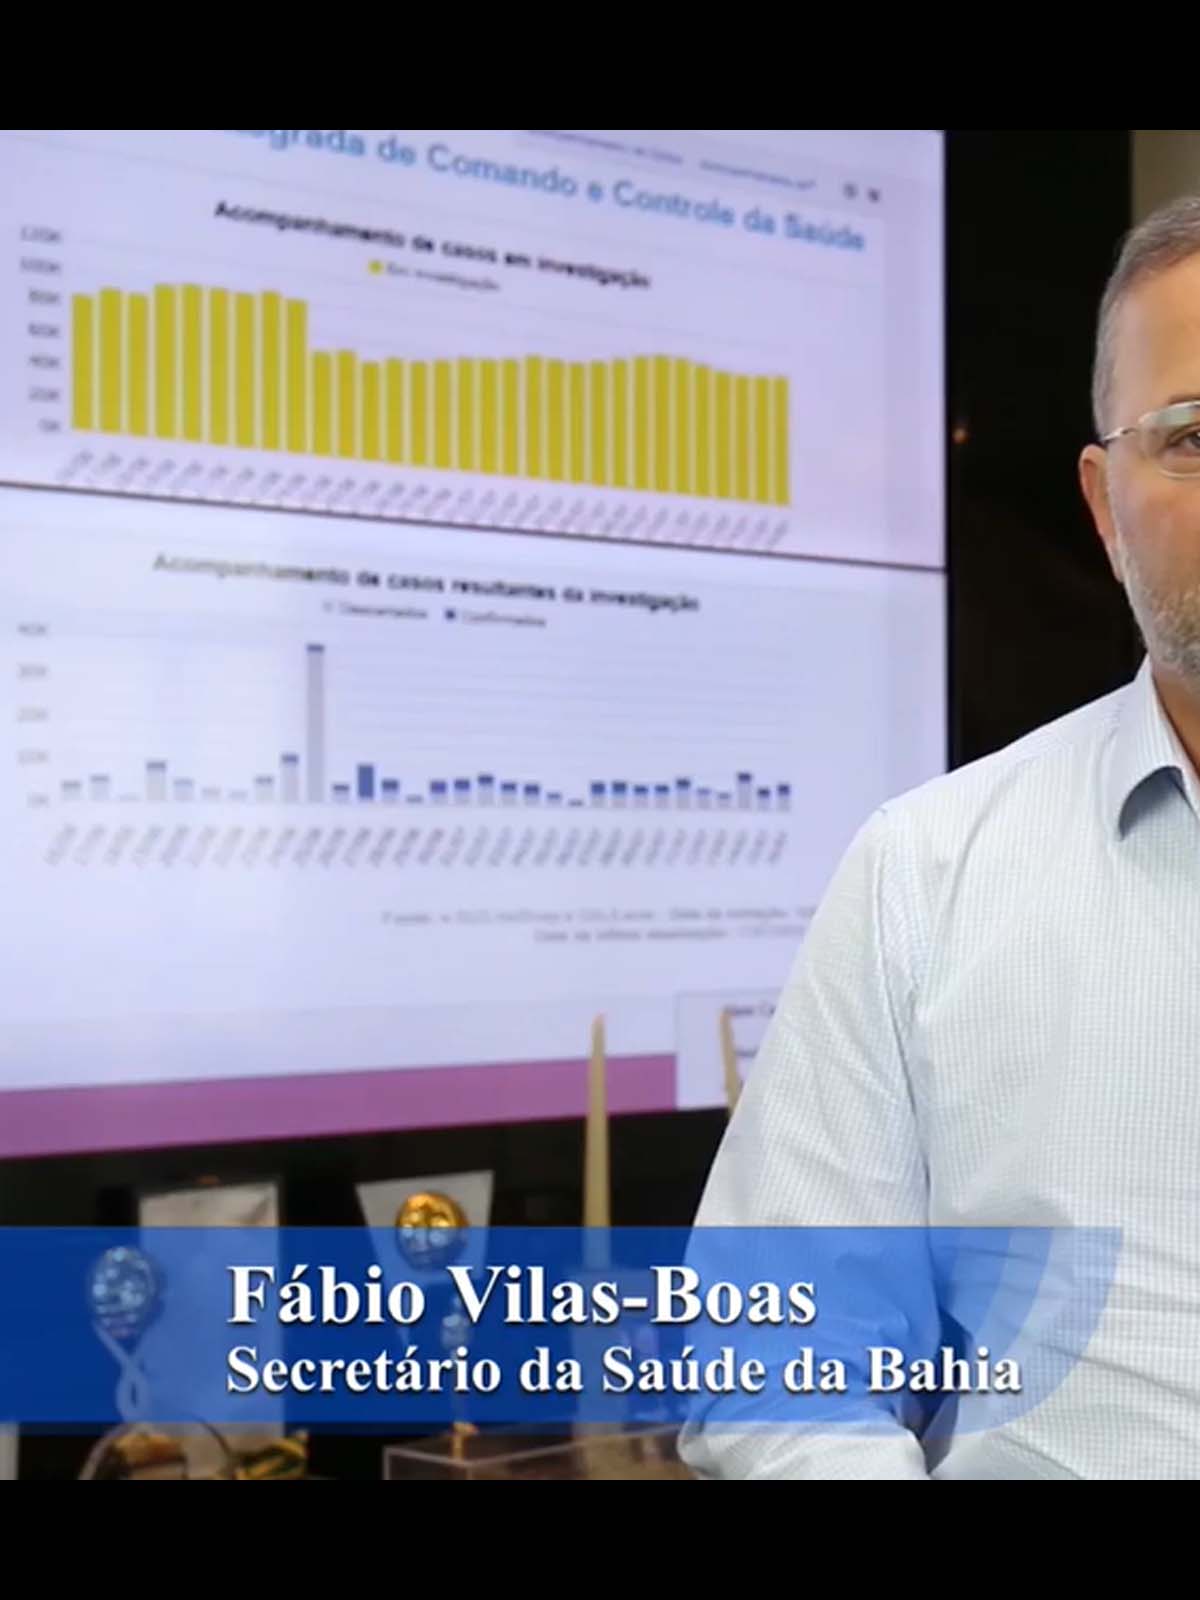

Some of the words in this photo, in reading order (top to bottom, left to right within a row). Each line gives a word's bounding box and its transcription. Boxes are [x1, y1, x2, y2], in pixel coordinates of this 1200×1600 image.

[376, 134, 417, 166] de
[426, 143, 579, 197] Comando
[612, 179, 735, 228] Controle
[742, 206, 776, 236] da
